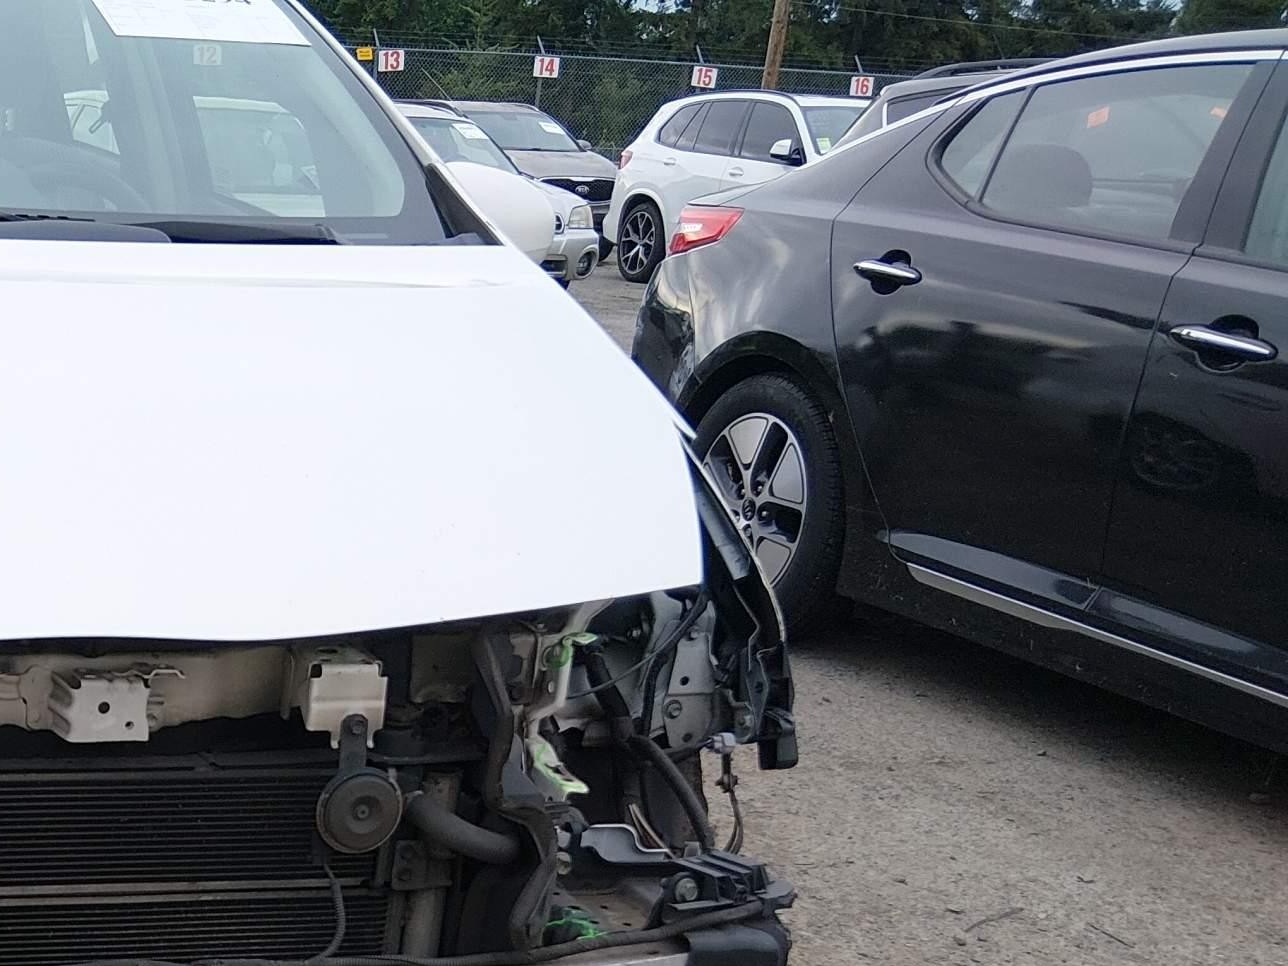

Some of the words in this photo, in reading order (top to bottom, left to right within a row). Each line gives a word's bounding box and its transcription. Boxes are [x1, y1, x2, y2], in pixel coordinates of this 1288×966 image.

[197, 46, 217, 65] 12
[383, 51, 400, 70] 13
[539, 57, 555, 76] 14
[697, 67, 713, 86] 15
[855, 77, 869, 95] 16
